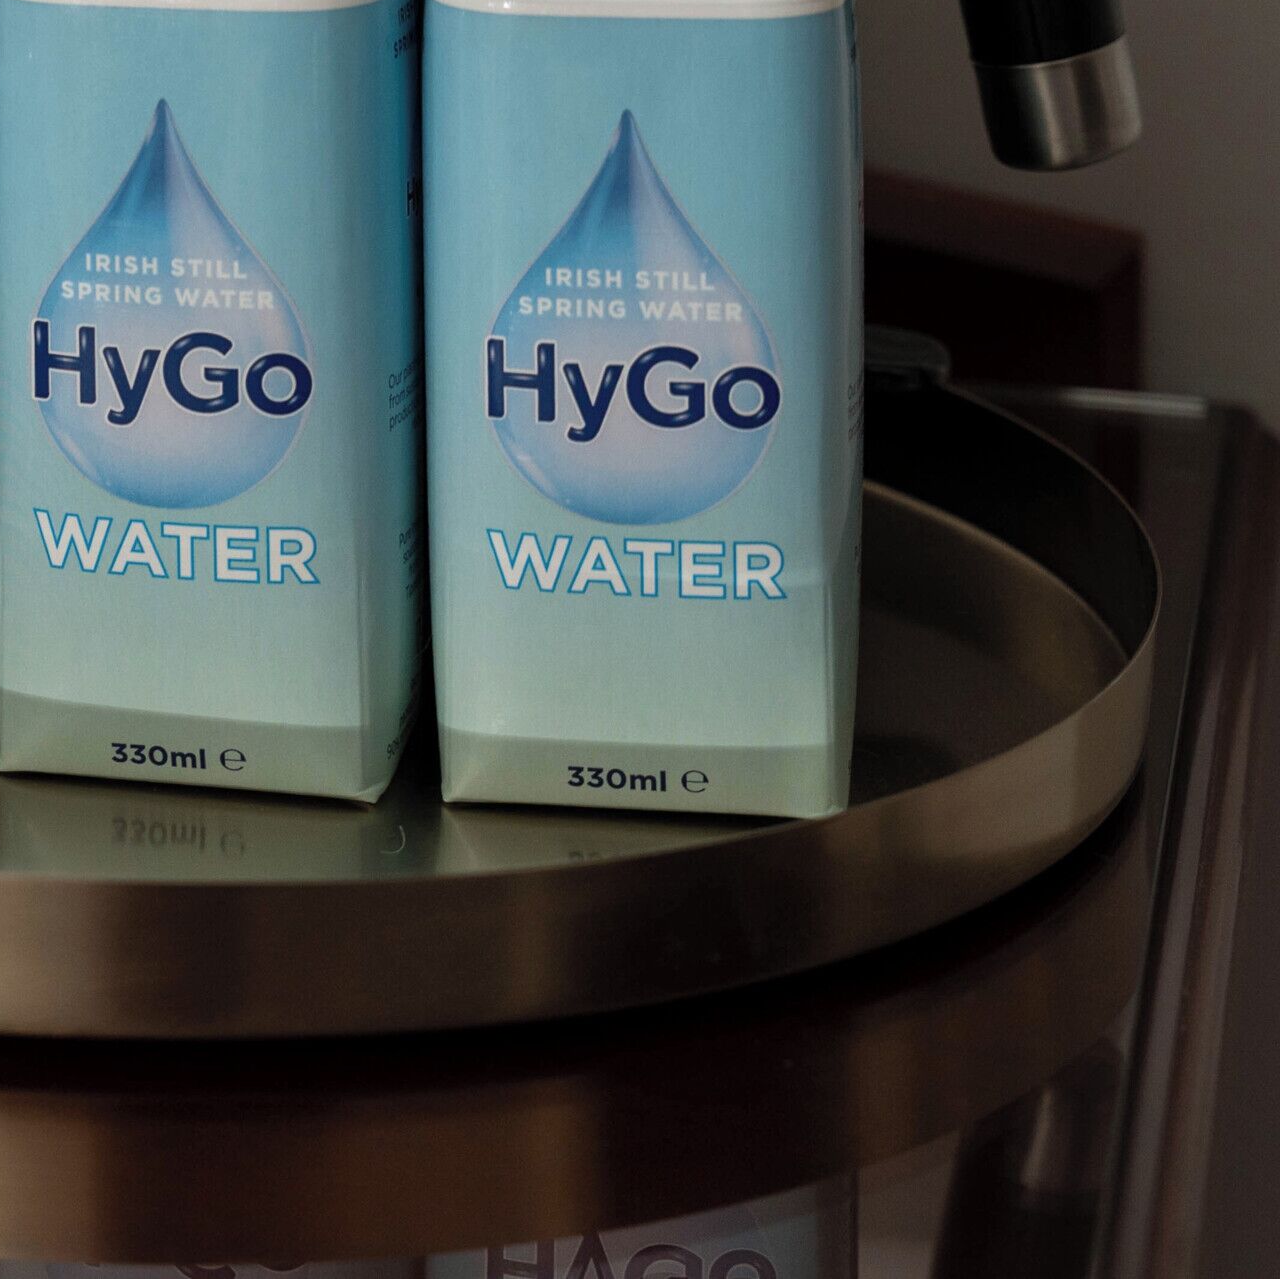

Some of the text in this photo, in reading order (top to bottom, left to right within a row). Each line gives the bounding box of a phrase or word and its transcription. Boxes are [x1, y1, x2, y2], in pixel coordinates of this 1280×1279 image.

[85, 252, 248, 280] IRISH STILL
[545, 266, 715, 292] IRISH STILL
[60, 280, 275, 310] SPRING WATER
[518, 295, 743, 322] SPRING WATER
[32, 320, 313, 425] HyGo
[485, 337, 782, 442] HyGo
[33, 508, 320, 585] WATER
[486, 529, 788, 601] WATER
[111, 742, 207, 769] 330ml
[567, 765, 667, 792] 330ml
